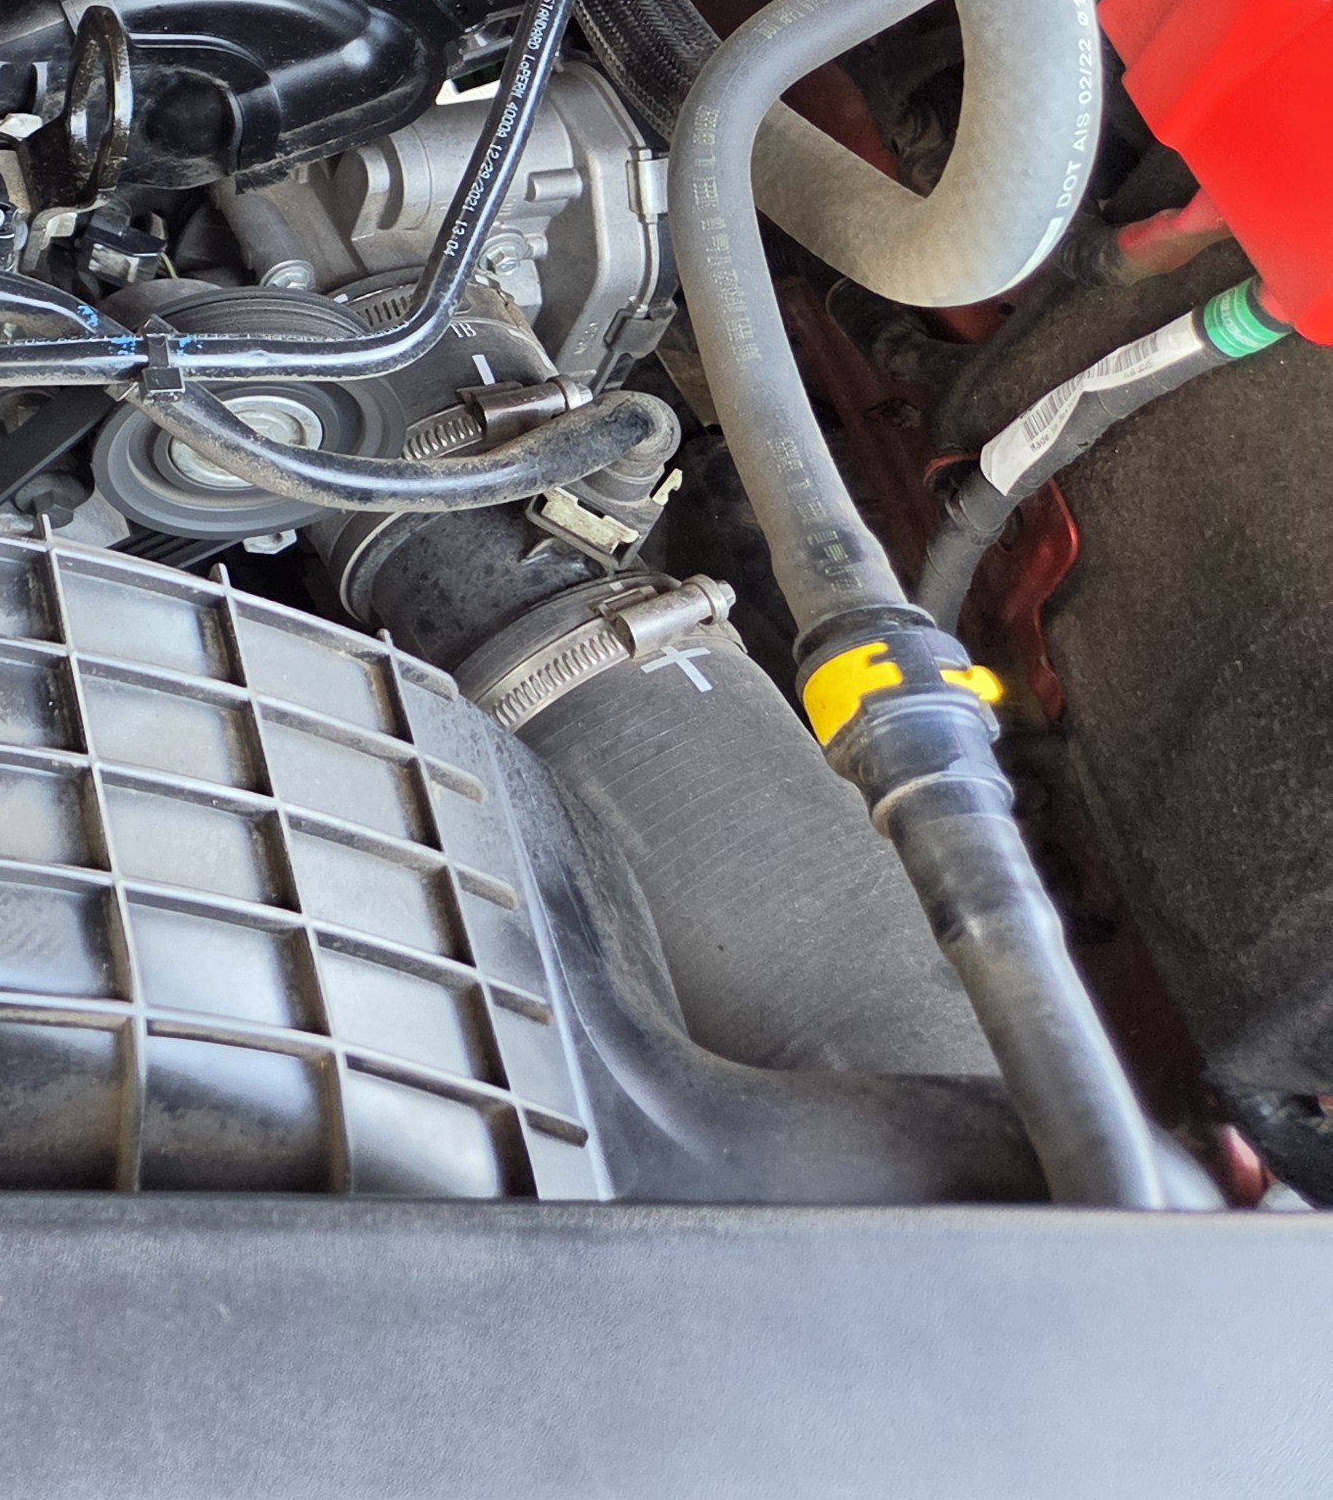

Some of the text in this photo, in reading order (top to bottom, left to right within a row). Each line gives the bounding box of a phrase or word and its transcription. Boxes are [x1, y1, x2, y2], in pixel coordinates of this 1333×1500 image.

[511, 53, 536, 100] LoPERM
[1077, 38, 1093, 105] 02/22
[495, 102, 519, 139] 4000A
[1072, 112, 1090, 153] AIS
[462, 143, 502, 212] 12/29/2021
[1055, 160, 1082, 209] DOT
[443, 219, 468, 257] 13:04
